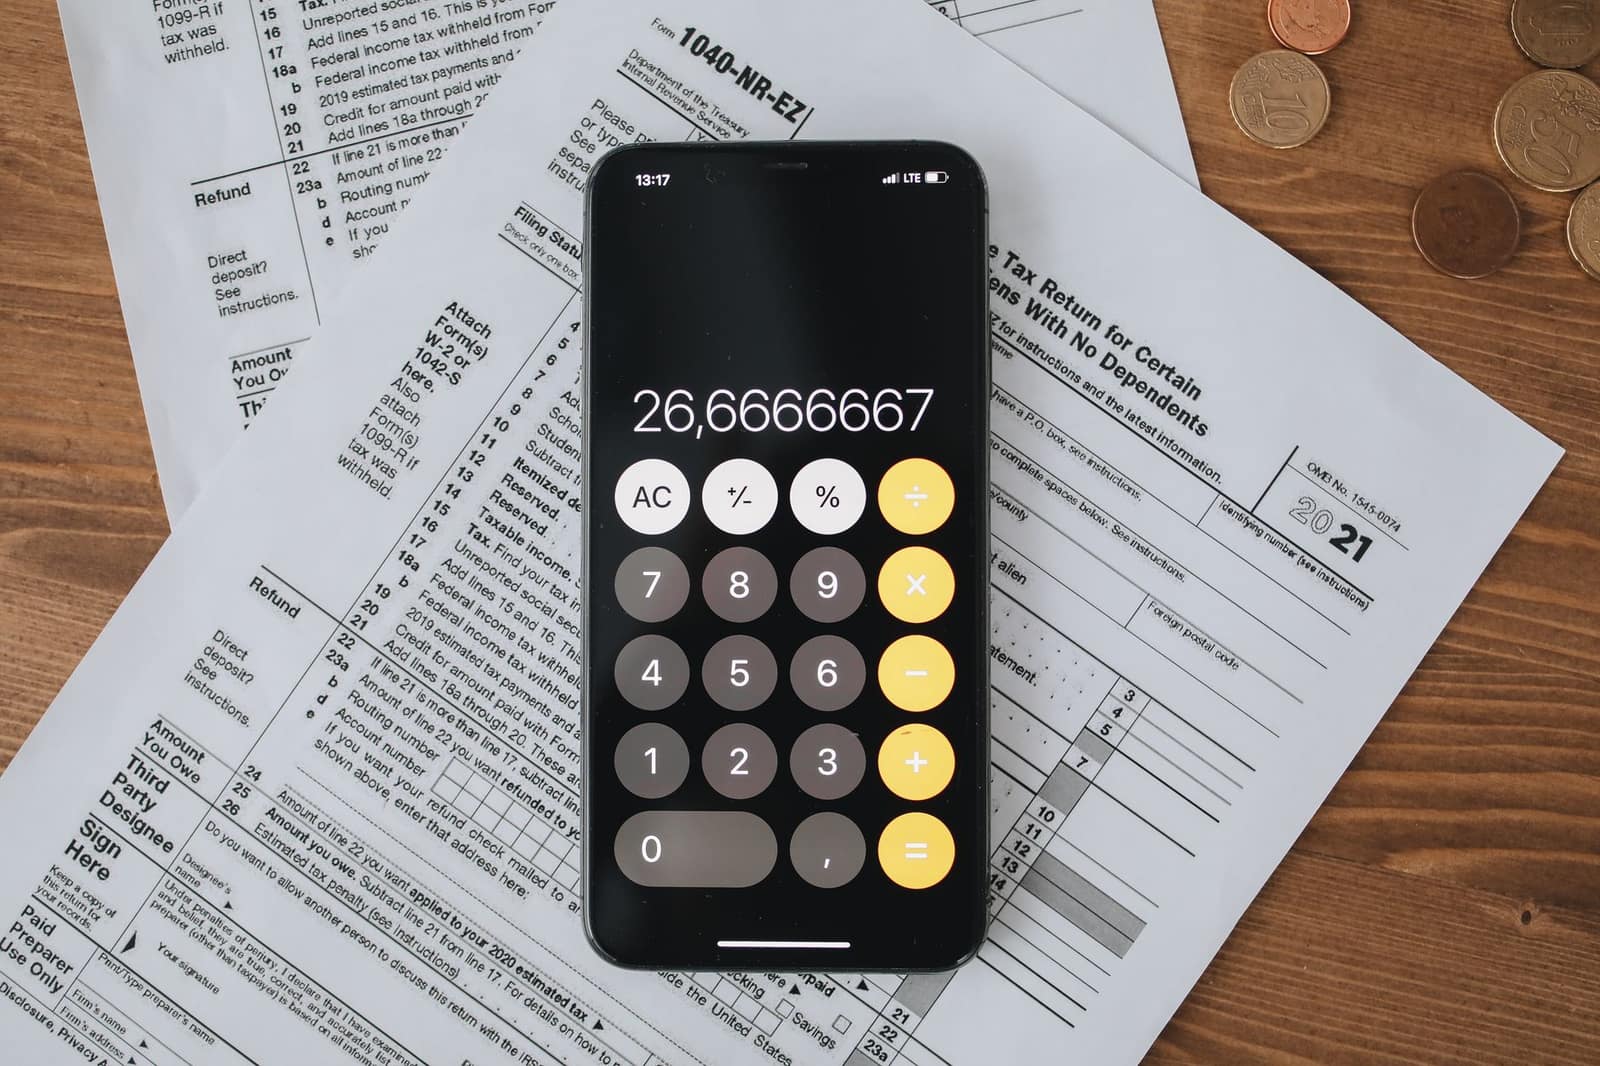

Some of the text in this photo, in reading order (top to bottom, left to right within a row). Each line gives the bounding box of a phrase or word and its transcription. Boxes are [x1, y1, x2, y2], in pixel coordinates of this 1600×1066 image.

[156, 0, 224, 30] 1099-R if
[159, 23, 218, 47] tax was
[266, 0, 489, 61] 17 Add lines 15 and 16. This is
[163, 36, 230, 65] withheld.
[649, 16, 808, 125] Form 1040-NR-EZ
[620, 57, 732, 140] Internal Revenue Service
[625, 47, 751, 139] Department of the Treasury
[286, 97, 473, 155] 21 Add lines 18a through
[589, 97, 636, 136] Please
[569, 128, 597, 154] See
[295, 146, 443, 195] 23a Amount of line 22
[635, 173, 671, 187] 13:17
[903, 172, 921, 184] LTE
[193, 180, 252, 208] Refund
[517, 204, 550, 238] Filing
[206, 248, 249, 269] Direct
[210, 259, 268, 286] deposit?
[213, 286, 242, 302] See
[216, 289, 300, 318] instructions.
[433, 313, 489, 362] Form(s)
[443, 303, 493, 340] Attach
[1001, 249, 1203, 402] Tax Return for Certain
[230, 346, 292, 375] Amount
[413, 346, 463, 386] 1042-S
[423, 328, 472, 370] W-2 or
[1023, 295, 1209, 438] With No Dependents
[231, 373, 266, 391] You
[389, 373, 421, 404] Also
[399, 359, 435, 394] here.
[378, 393, 421, 428] attach
[633, 388, 935, 440] 26,6666667
[997, 320, 1222, 486] for instructions and the latest information.
[359, 421, 421, 472] 1099-R if
[367, 404, 420, 450] Form(s)
[338, 452, 394, 501] withheld.
[346, 436, 399, 480] tax was
[454, 462, 549, 539] 13 Reserved.
[632, 485, 672, 509] AC
[815, 485, 840, 509] %
[1305, 461, 1402, 533] OMB No. 1545-0074
[642, 570, 839, 599] 7 8 9
[1262, 531, 1299, 560] number
[1314, 566, 1370, 613] instructions)
[247, 574, 302, 620] Refund
[211, 628, 249, 662] Direct
[1145, 599, 1245, 671] Foreign postal code
[193, 656, 218, 681] See
[202, 645, 255, 686] deposit?
[641, 659, 838, 688] 4 5 6
[182, 668, 250, 728] instructions.
[1110, 705, 1125, 720] 4
[1122, 686, 1136, 703] 3
[315, 693, 428, 777] d Account number
[326, 673, 441, 762] b Routing number
[1098, 719, 1114, 737] 5
[141, 730, 201, 785] You Owe
[148, 718, 206, 766] Amount
[644, 747, 838, 776] 1 2 3
[1075, 754, 1090, 770] 7
[110, 770, 158, 814] Party
[125, 752, 172, 795] Third
[97, 788, 175, 854] Designee
[313, 737, 354, 773] shown
[352, 767, 391, 804] above,
[393, 797, 428, 824] enter
[424, 817, 452, 843] that
[449, 837, 499, 878] address
[1036, 805, 1056, 824] 10
[78, 817, 123, 860] Sign
[641, 835, 662, 863] 0
[1012, 836, 1031, 859] 12
[1024, 822, 1043, 841] 11
[63, 837, 111, 882] Here
[999, 855, 1020, 874] 13
[19, 903, 57, 938] Paid
[0, 935, 65, 995] Use Only
[7, 919, 75, 975] Preparer
[156, 940, 220, 996] Your signature
[0, 980, 99, 1063] Disclosure, Privacy
[684, 983, 793, 1066] the United States
[790, 1009, 837, 1051] Savings
[877, 1023, 899, 1044] 22
[889, 1006, 911, 1026] 21
[862, 1037, 889, 1063] 23a
